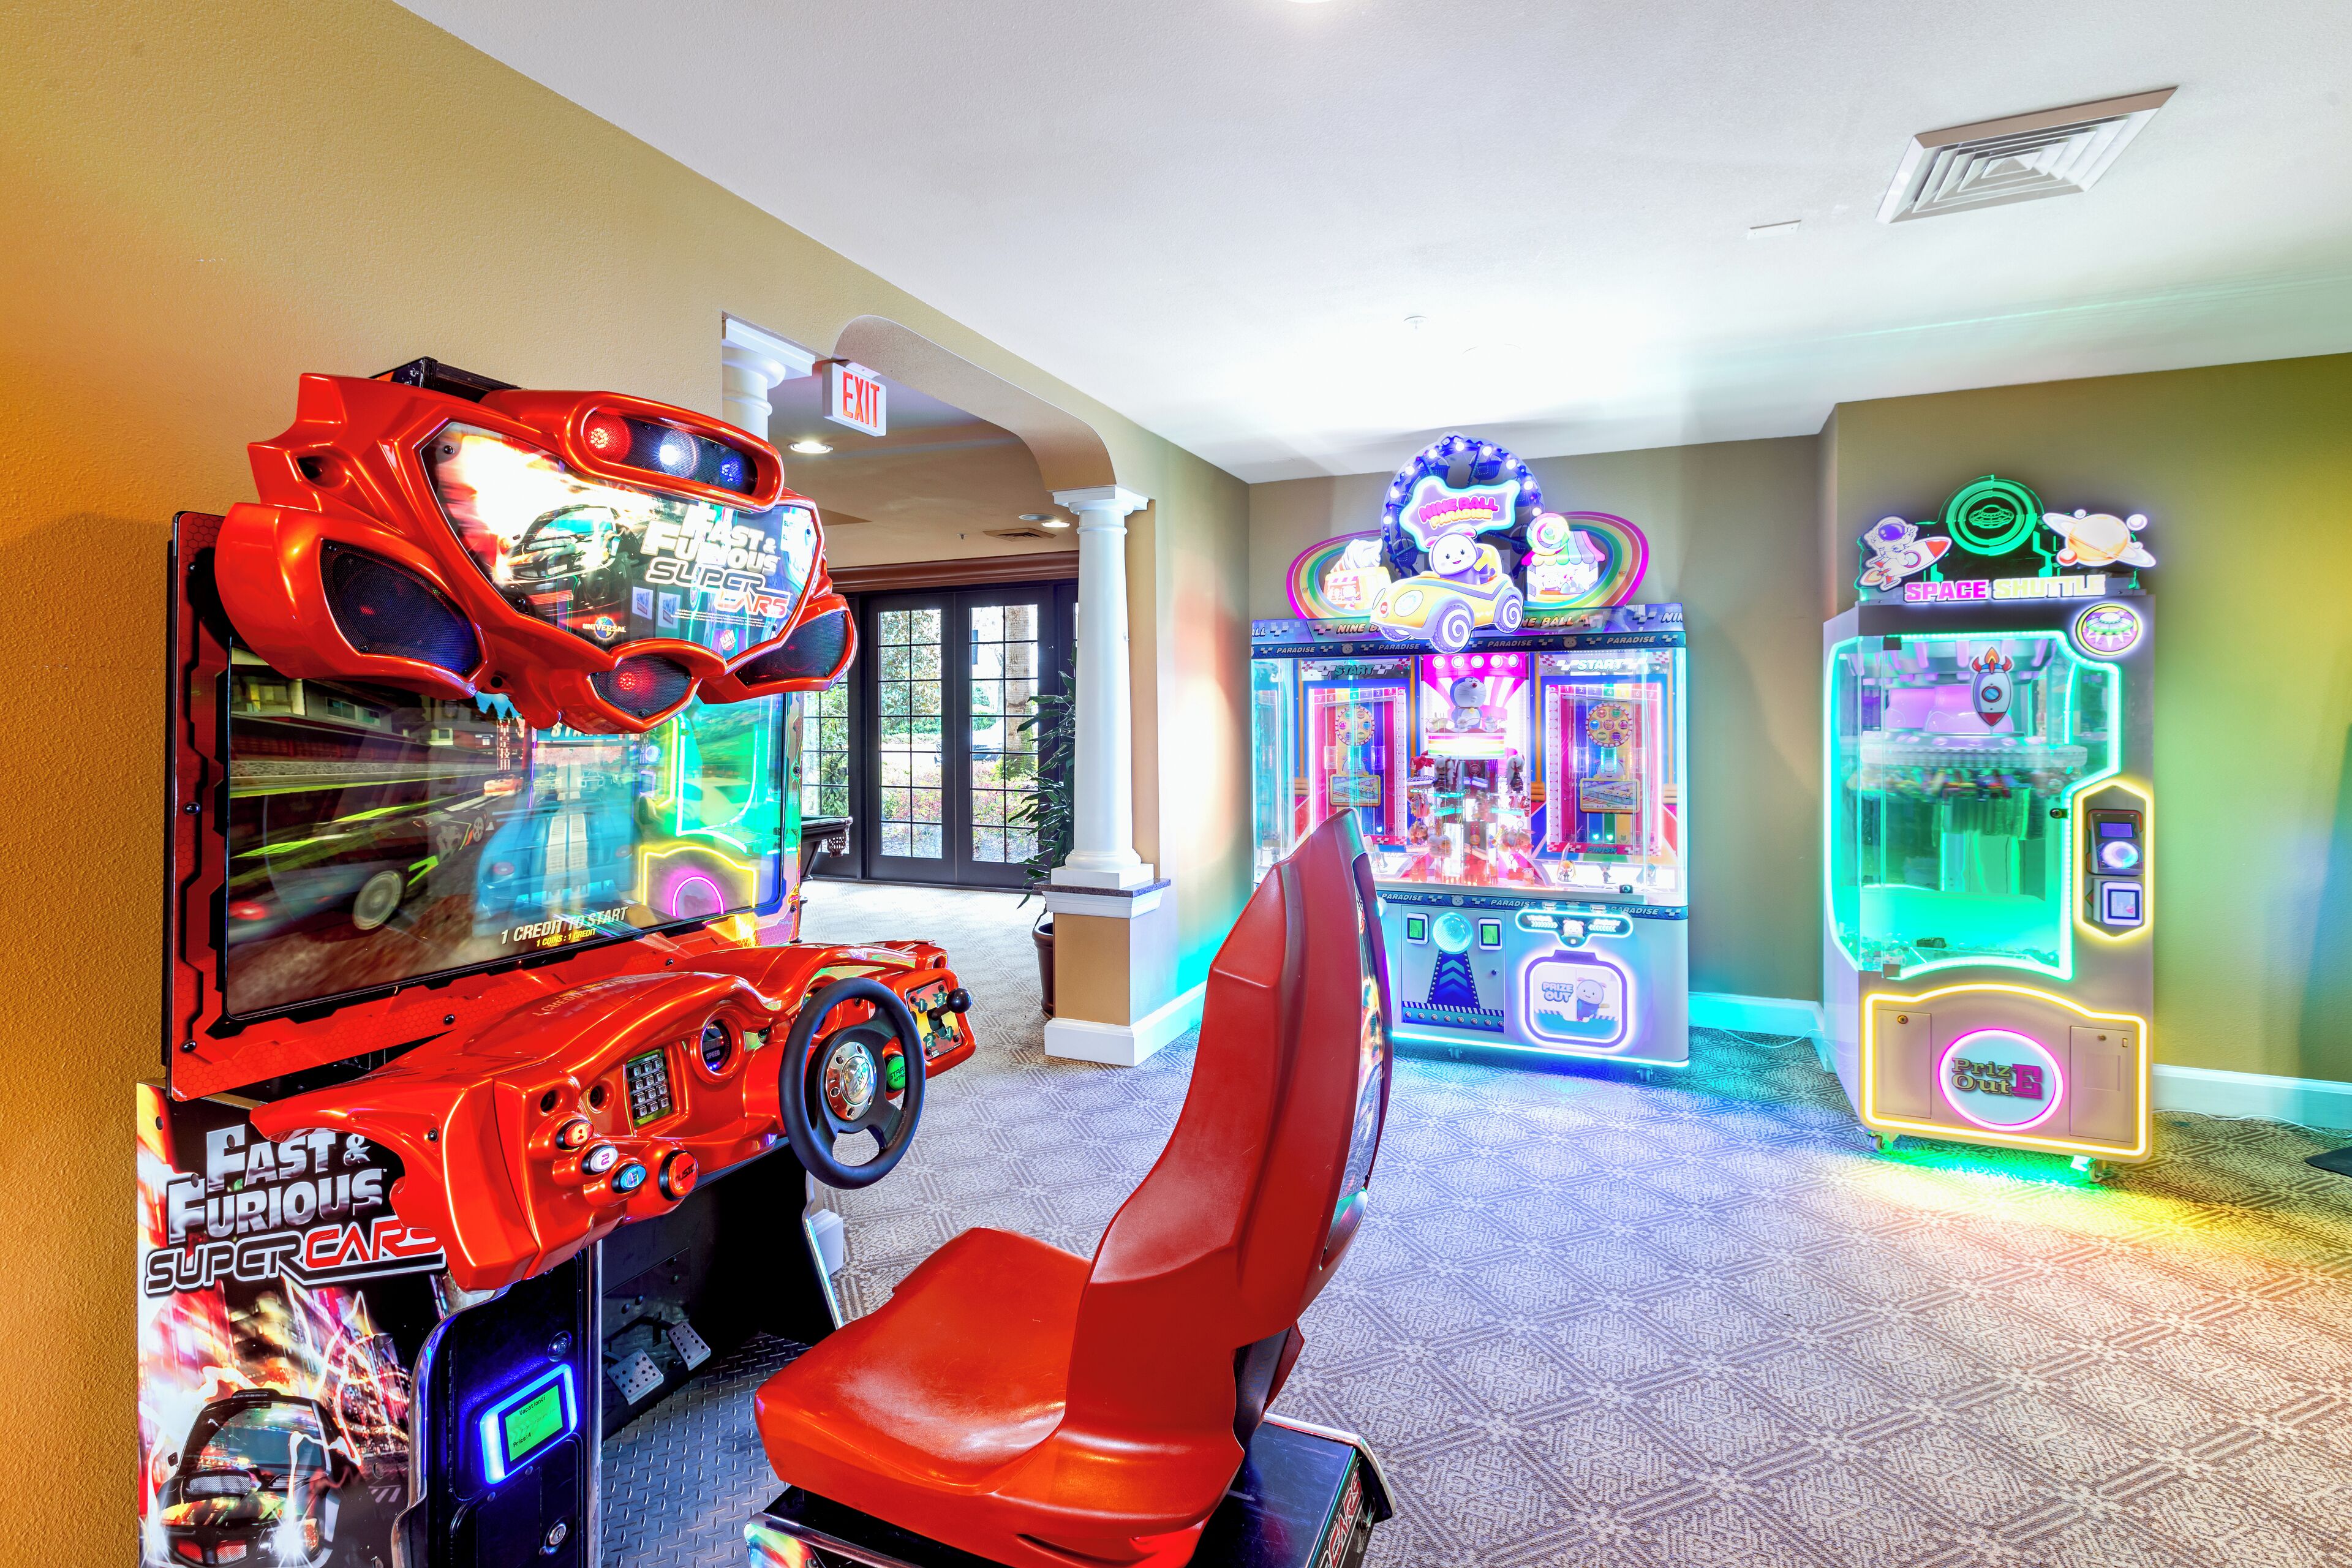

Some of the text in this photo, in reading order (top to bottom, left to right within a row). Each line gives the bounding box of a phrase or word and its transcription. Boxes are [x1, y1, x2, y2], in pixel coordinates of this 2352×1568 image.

[843, 371, 880, 428] EXIT
[1419, 497, 1499, 522] NINE BALL
[1430, 508, 1493, 528] PARADISE
[680, 502, 764, 551] FAST
[763, 538, 776, 554] &
[641, 520, 778, 576] FUOUS
[645, 556, 771, 594] SUPER
[1904, 575, 2106, 603] SPACE SHUTTLE
[582, 624, 627, 633] UNIVERSAL
[1336, 624, 1366, 634] NINE
[1541, 616, 1574, 628] BALL
[1335, 664, 1374, 676] START
[1577, 658, 1624, 672] START
[501, 906, 629, 944] 1 CREDIT TO START
[542, 935, 562, 946] COINS
[574, 927, 597, 940] CREDIT
[1542, 981, 1574, 992] PRIZE
[920, 993, 943, 1011] 1 3
[1544, 990, 1572, 1003] OUT
[927, 1036, 932, 1046] 2
[706, 1049, 720, 1060] SPEED
[889, 1066, 905, 1080] STAR
[206, 1124, 371, 1193] FAST &
[601, 1152, 610, 1166] 2
[168, 1168, 382, 1245] FURIOUS
